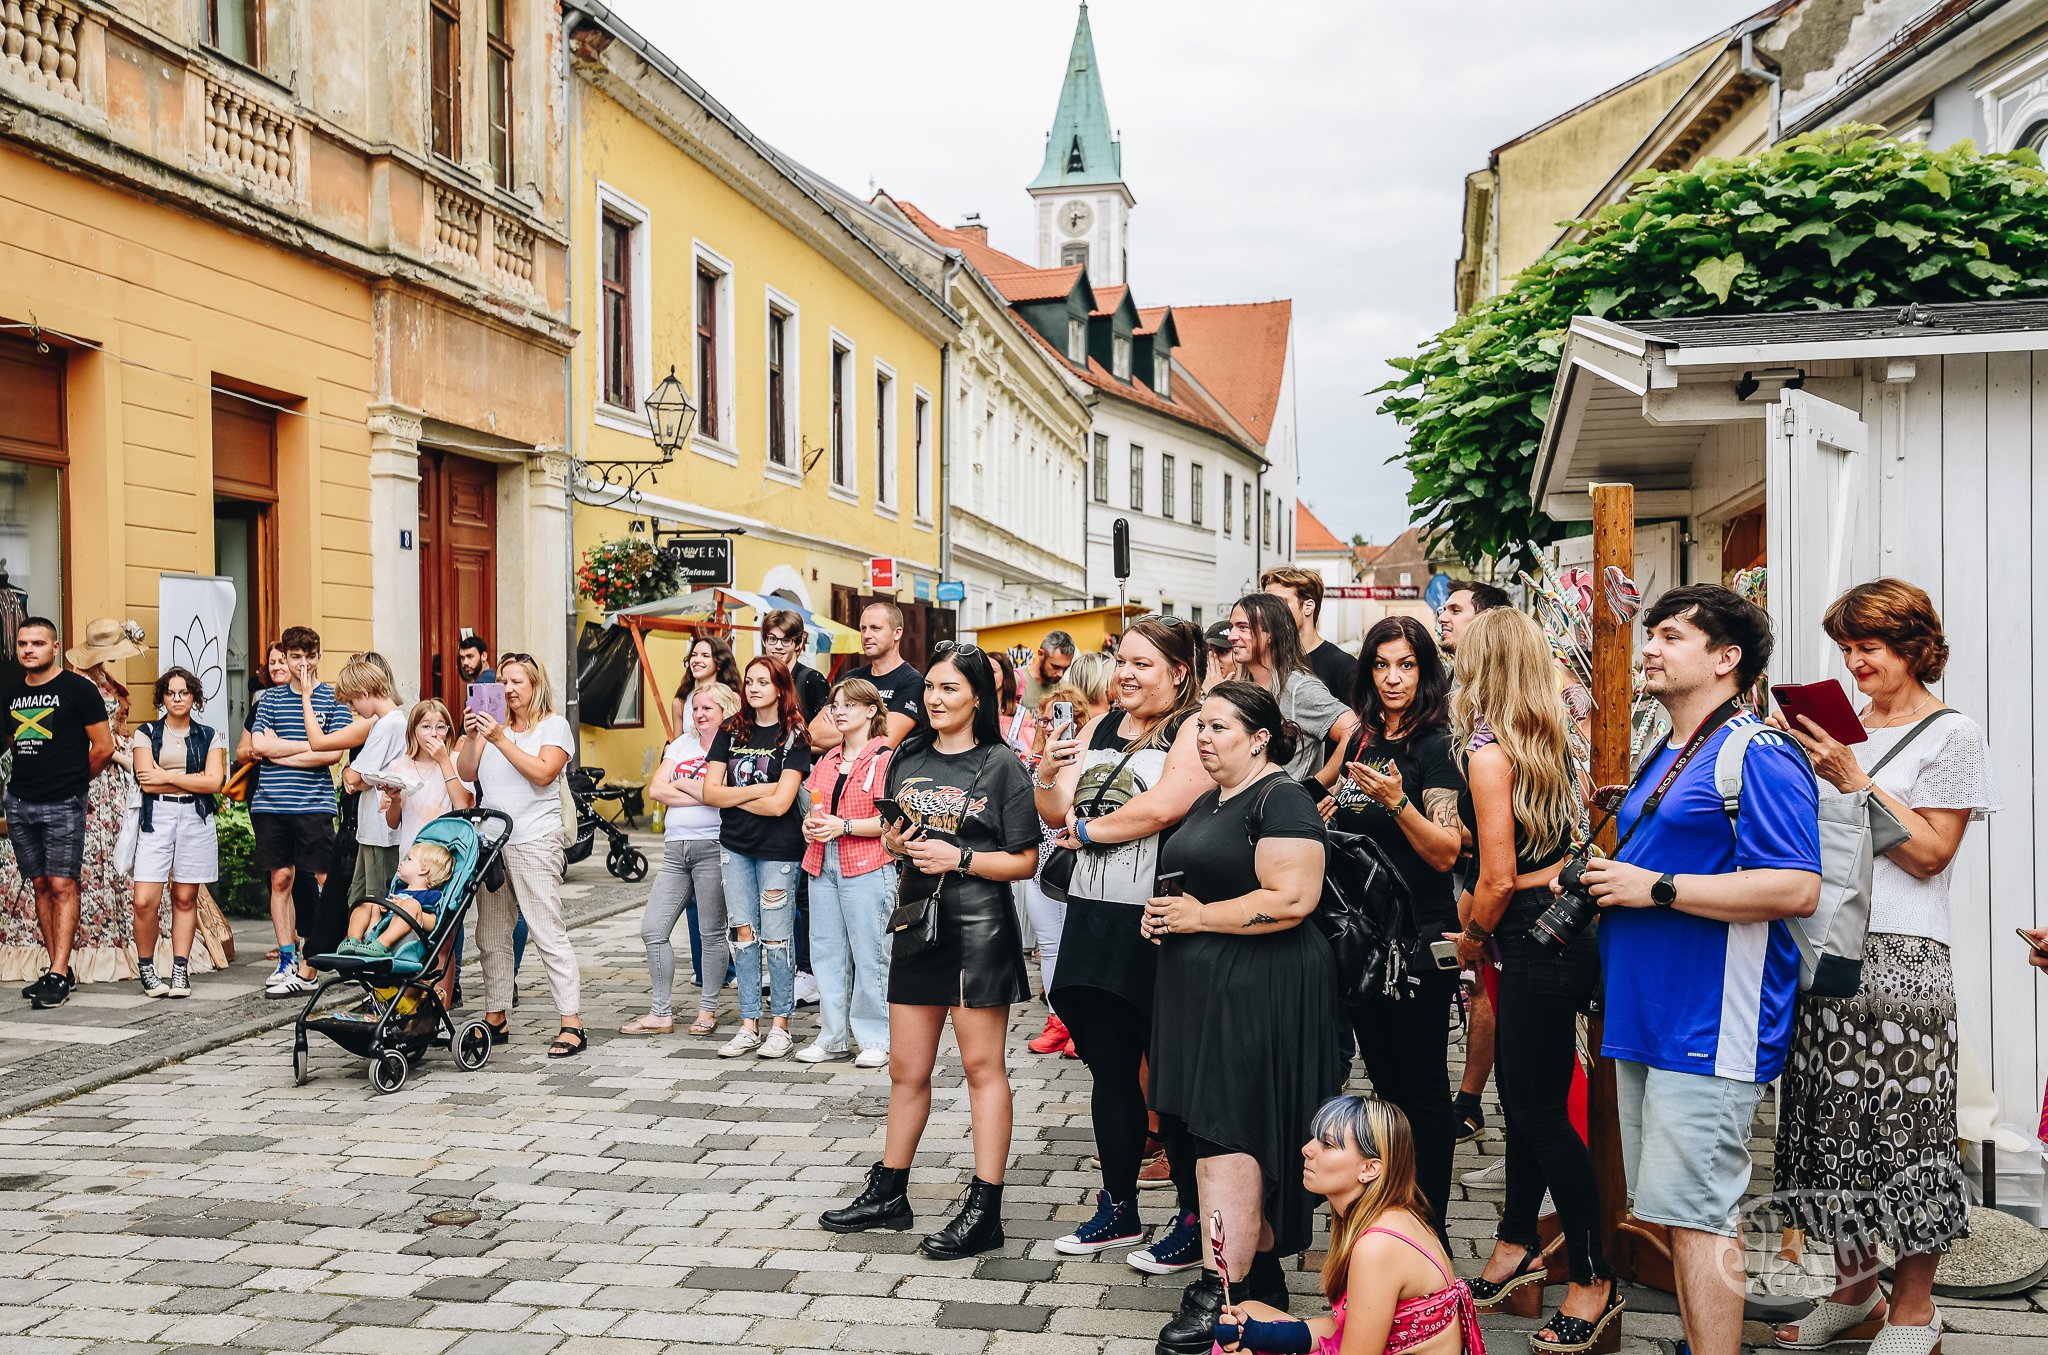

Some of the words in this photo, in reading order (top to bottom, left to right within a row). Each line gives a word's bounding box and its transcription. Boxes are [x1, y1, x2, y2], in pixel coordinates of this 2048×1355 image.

[405, 532, 410, 547] 8
[10, 695, 60, 710] JAMAICA
[1657, 770, 1677, 793] EOS
[1675, 757, 1687, 770] 5D
[1686, 741, 1700, 757] Mark
